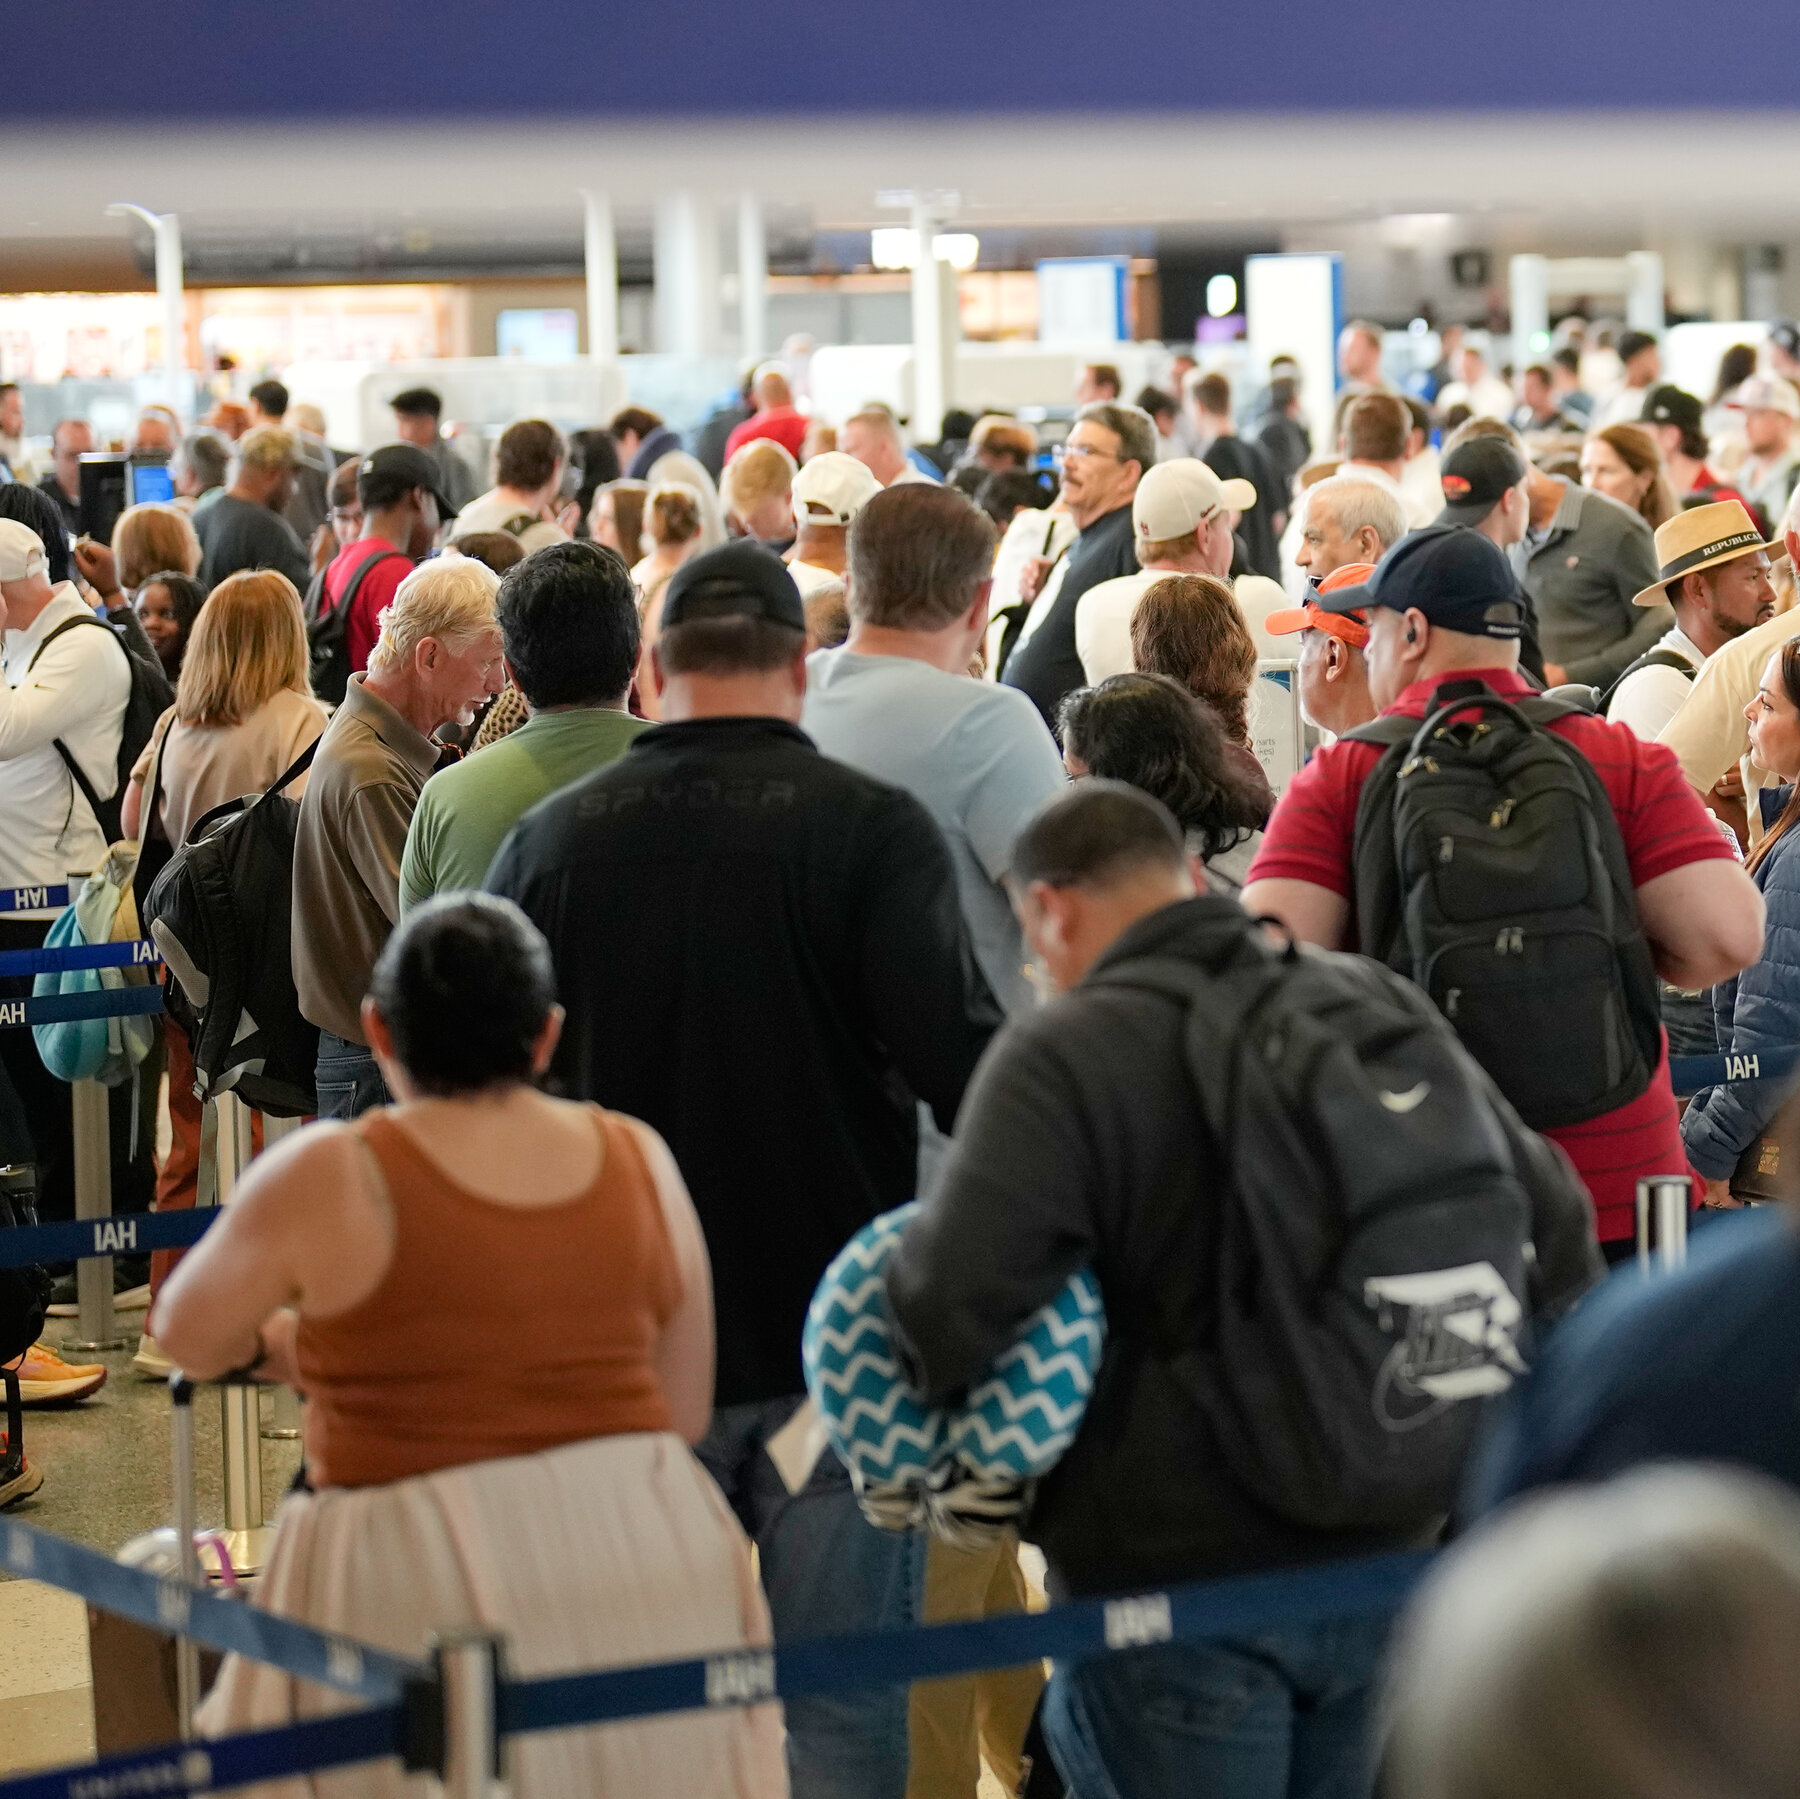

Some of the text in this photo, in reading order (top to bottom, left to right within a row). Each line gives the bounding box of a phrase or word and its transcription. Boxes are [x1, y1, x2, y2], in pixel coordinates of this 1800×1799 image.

[1702, 532, 1762, 556] REPUBLICA
[1725, 1053, 1760, 1081] IAH
[94, 1220, 137, 1252] IAH
